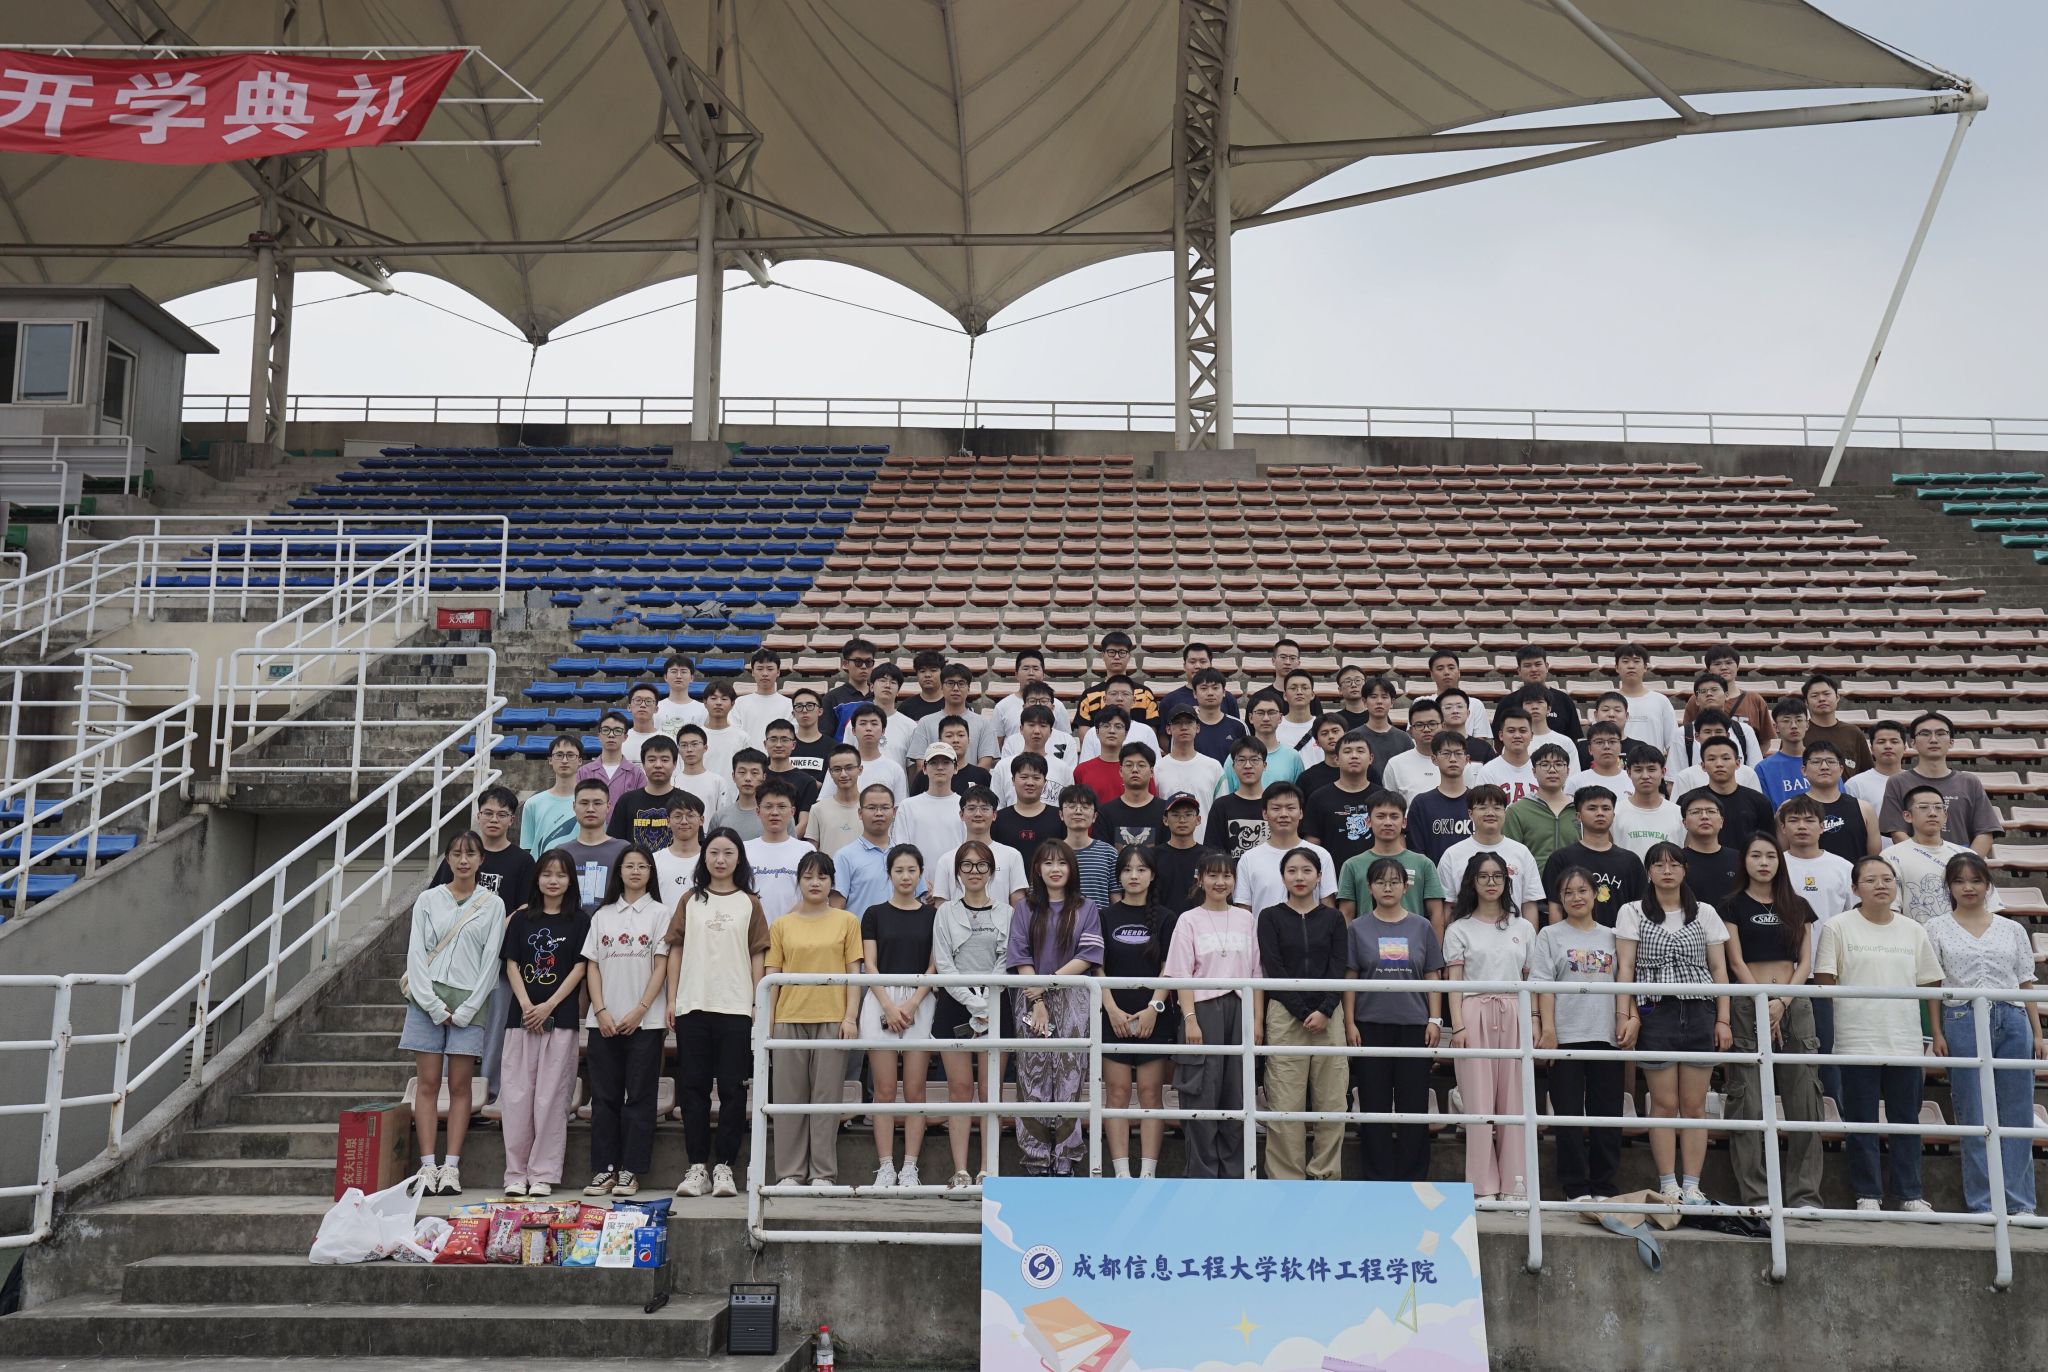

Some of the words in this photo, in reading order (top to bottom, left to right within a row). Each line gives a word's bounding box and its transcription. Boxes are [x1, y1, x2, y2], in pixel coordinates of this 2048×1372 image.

[0, 69, 408, 145] 开学典礼
[790, 759, 807, 767] NIKE
[342, 1137, 357, 1185] 农夫山泉
[1072, 1253, 1438, 1285] 成都信息工程大学软件工程学院
